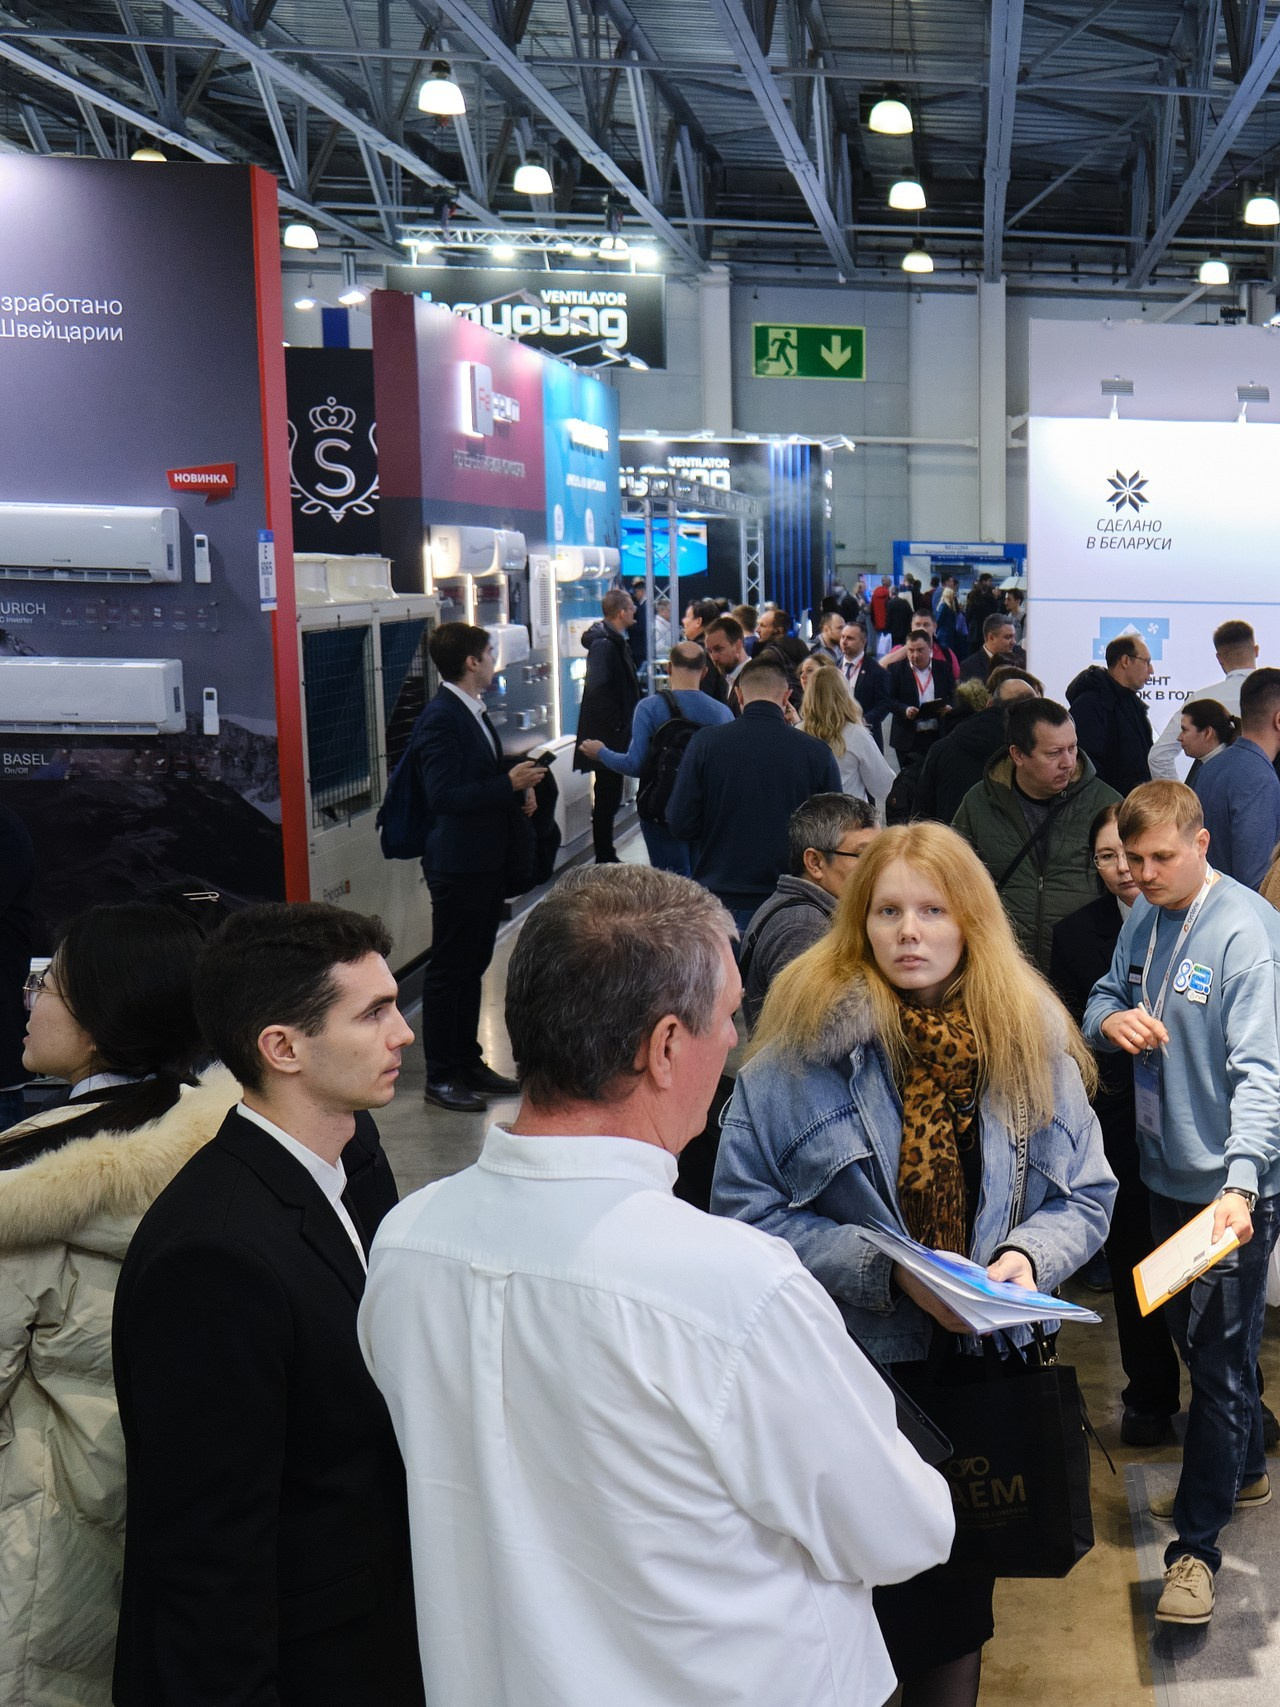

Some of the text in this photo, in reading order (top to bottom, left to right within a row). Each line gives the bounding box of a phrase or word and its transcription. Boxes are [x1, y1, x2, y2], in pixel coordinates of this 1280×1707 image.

[540, 289, 627, 306] VENTILATOR
[0, 319, 123, 344] Швейцарии
[667, 456, 731, 469] VENTILATOR
[174, 473, 228, 484] НОВИНКА
[1096, 518, 1162, 533] СДЕЛАНО
[1086, 536, 1172, 551] В БЕЛАРУСИ
[3, 753, 50, 767] BASEL
[4, 766, 29, 775] On/Off
